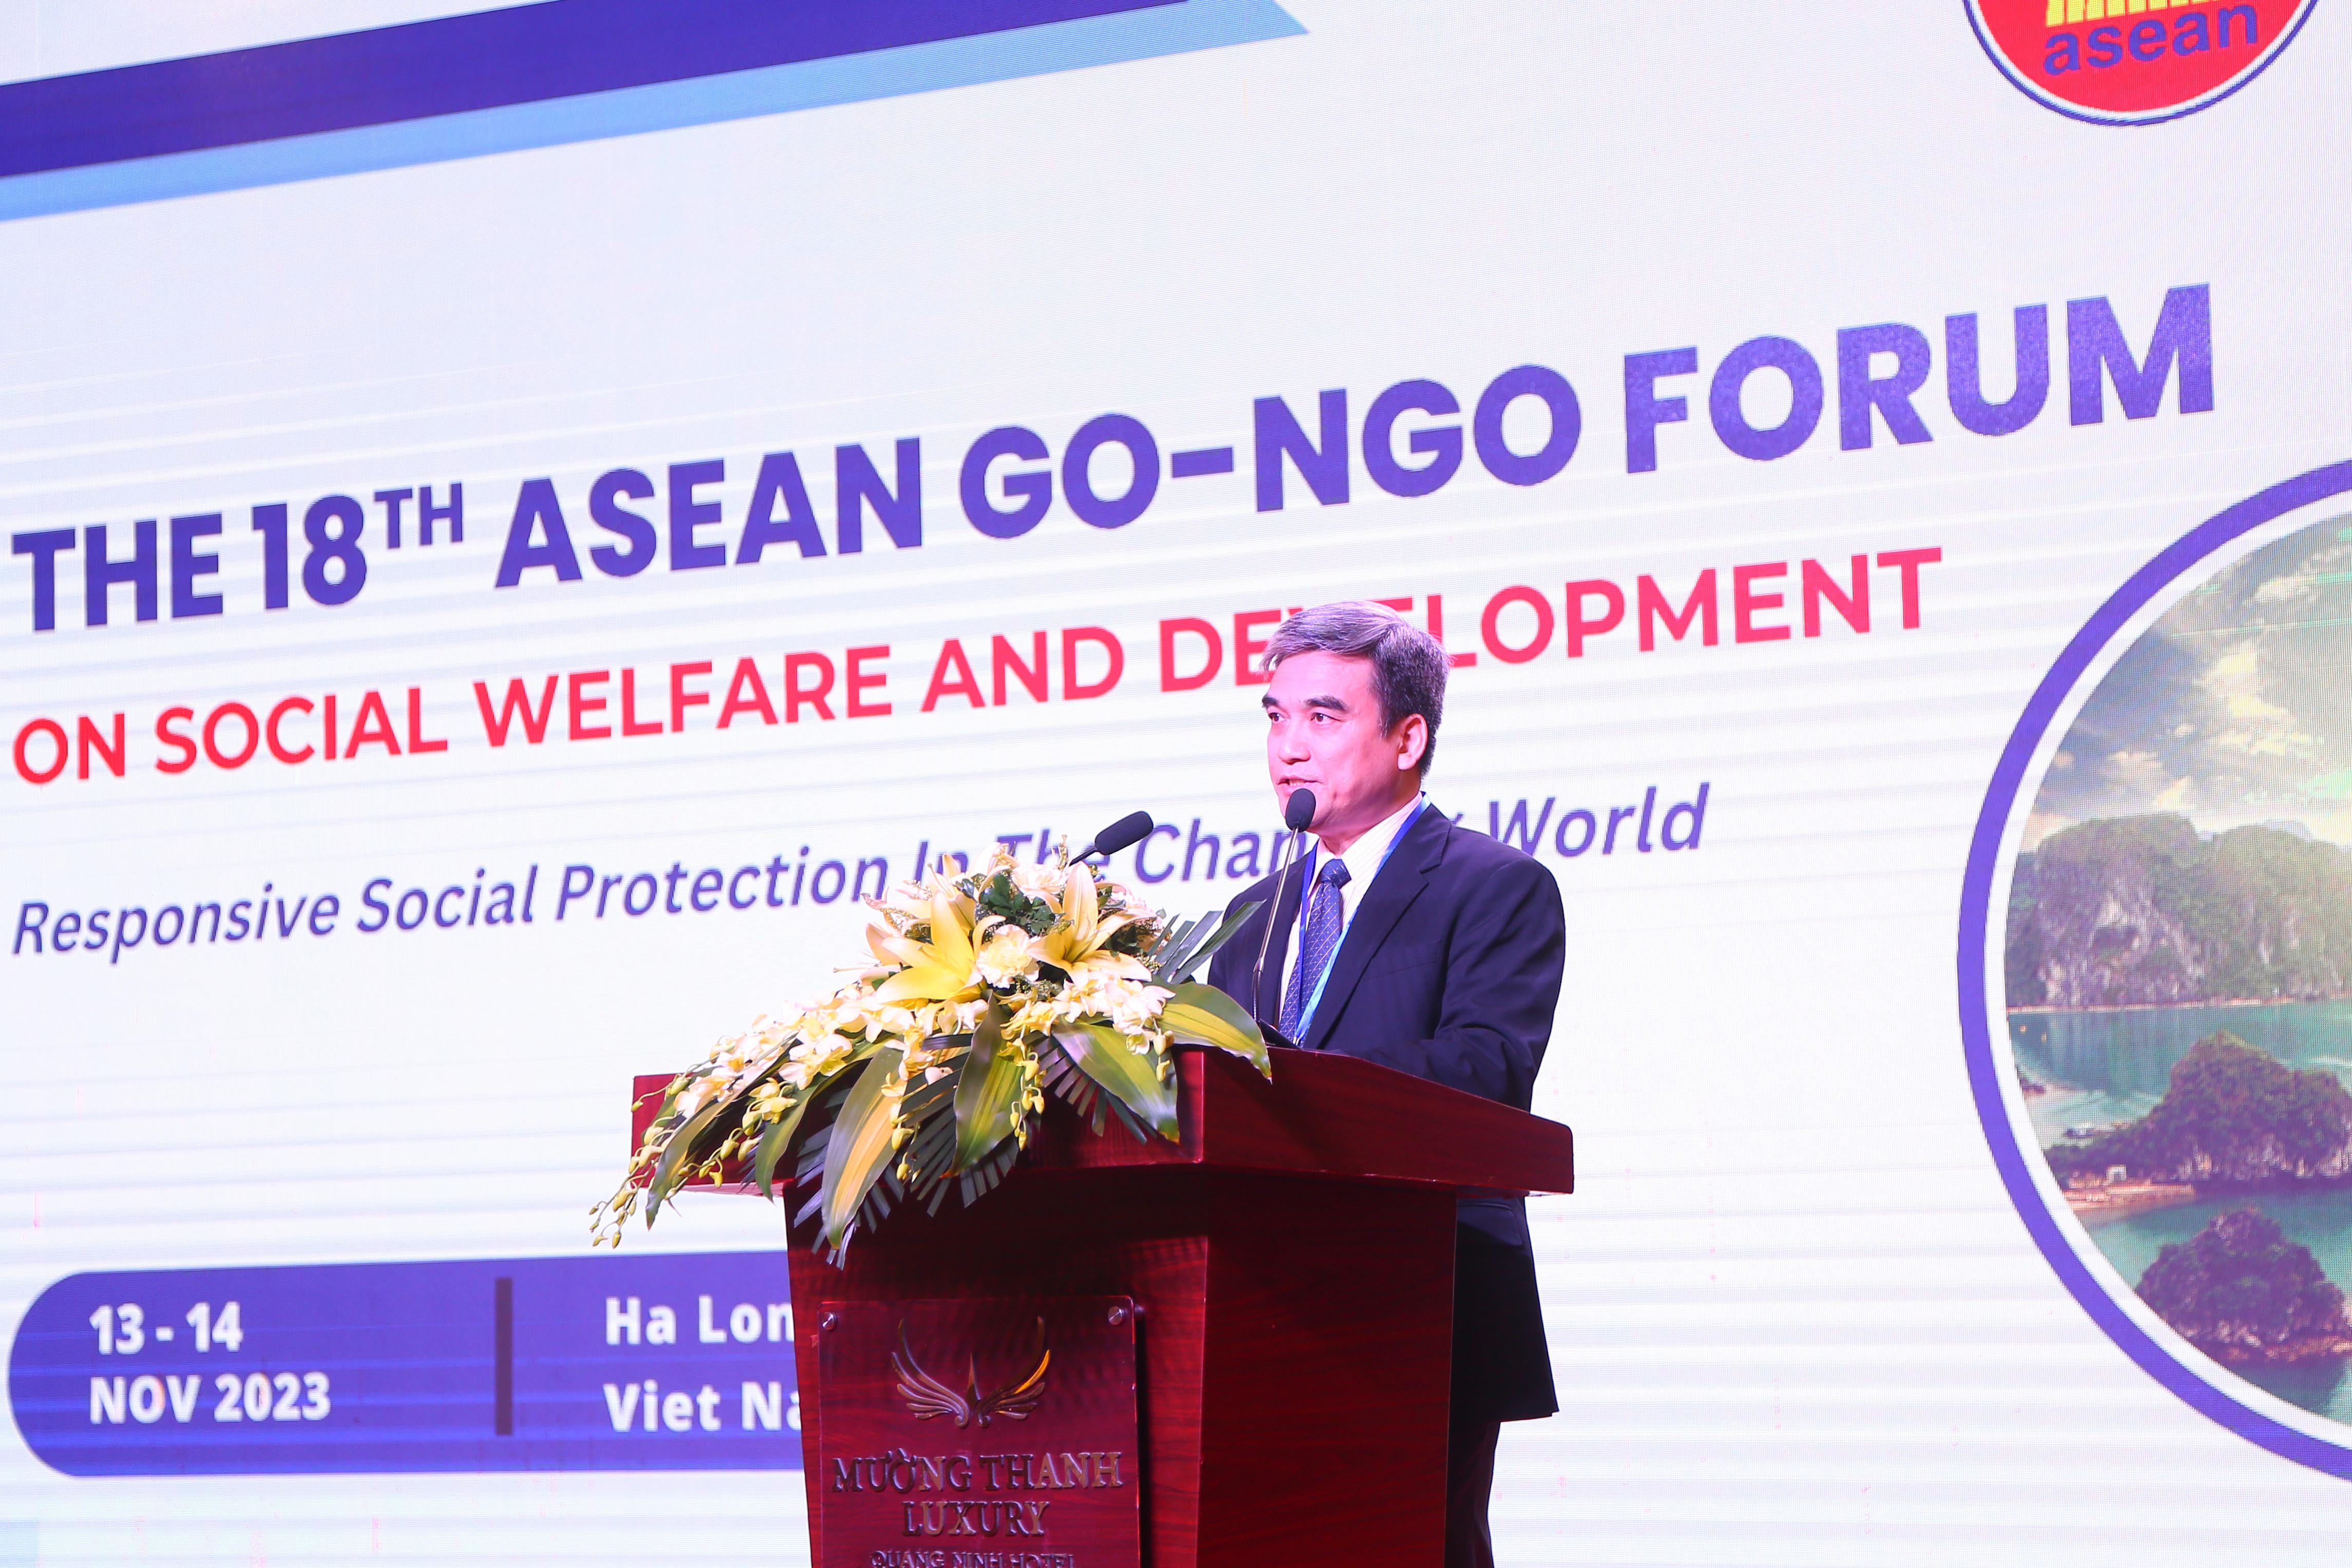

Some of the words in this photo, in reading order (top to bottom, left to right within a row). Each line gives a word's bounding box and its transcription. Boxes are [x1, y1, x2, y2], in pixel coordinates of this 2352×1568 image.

[2043, 5, 2258, 76] asean
[11, 512, 224, 632] THE
[252, 482, 463, 610] 18TH
[495, 437, 922, 588] ASEAN
[959, 364, 1582, 540] GO-NGO
[1624, 283, 2214, 474] FORUM
[13, 713, 125, 785] ON
[156, 687, 448, 774] SOCIAL
[473, 645, 893, 748] WELFARE
[920, 626, 1125, 713] AND
[1159, 546, 1942, 693] DELOPMENT
[13, 883, 340, 964] Responsive
[356, 865, 538, 932] Social
[557, 846, 888, 920] Protection
[1490, 781, 1710, 857] World
[89, 1303, 145, 1354] 13
[186, 1301, 243, 1352] 14
[605, 1296, 676, 1345] Ha
[698, 1294, 794, 1343] Lon
[89, 1375, 201, 1424] NOV
[214, 1372, 331, 1422] 2023
[602, 1379, 722, 1432] Viet
[741, 1381, 802, 1431] Na
[831, 1448, 972, 1493] MƯỜNG
[979, 1451, 1124, 1489] THANH
[902, 1501, 1049, 1537] LUXURY
[952, 1551, 1003, 1568] NINH
